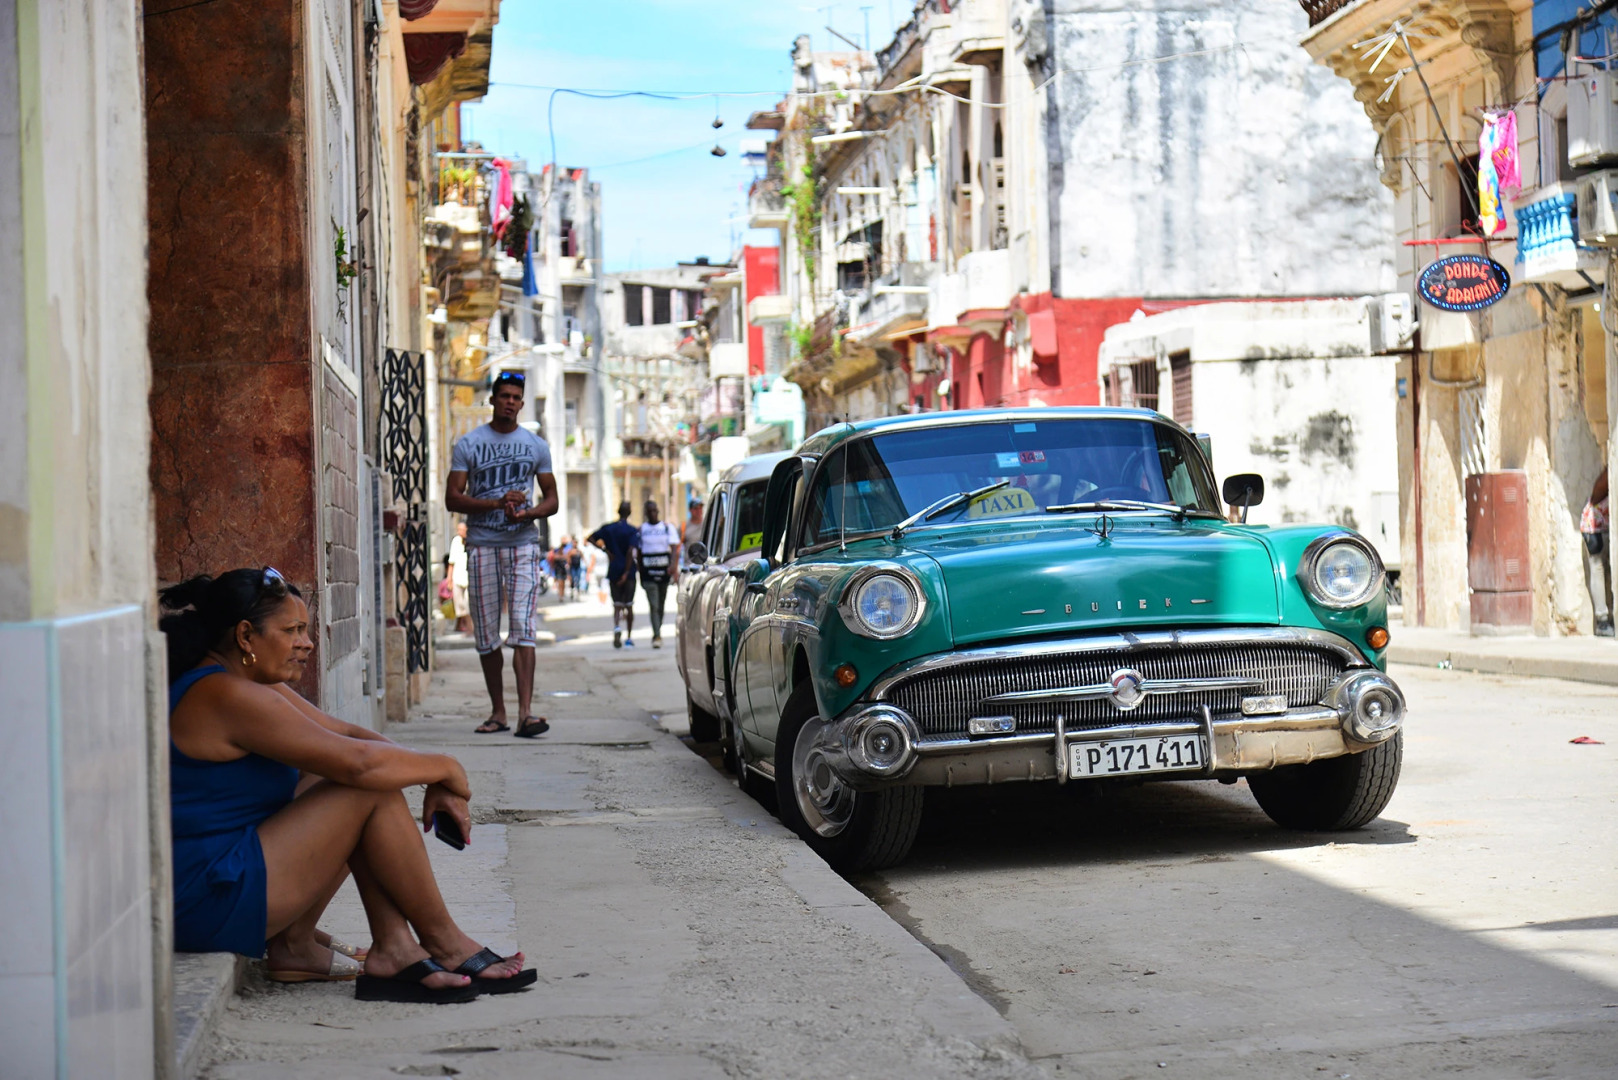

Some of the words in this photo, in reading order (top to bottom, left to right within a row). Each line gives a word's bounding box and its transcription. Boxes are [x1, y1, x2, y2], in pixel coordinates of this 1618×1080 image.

[1444, 262, 1490, 280] DONDE
[474, 461, 533, 492] WILD
[980, 493, 1025, 514] TAXI
[1064, 597, 1173, 614] BUICK
